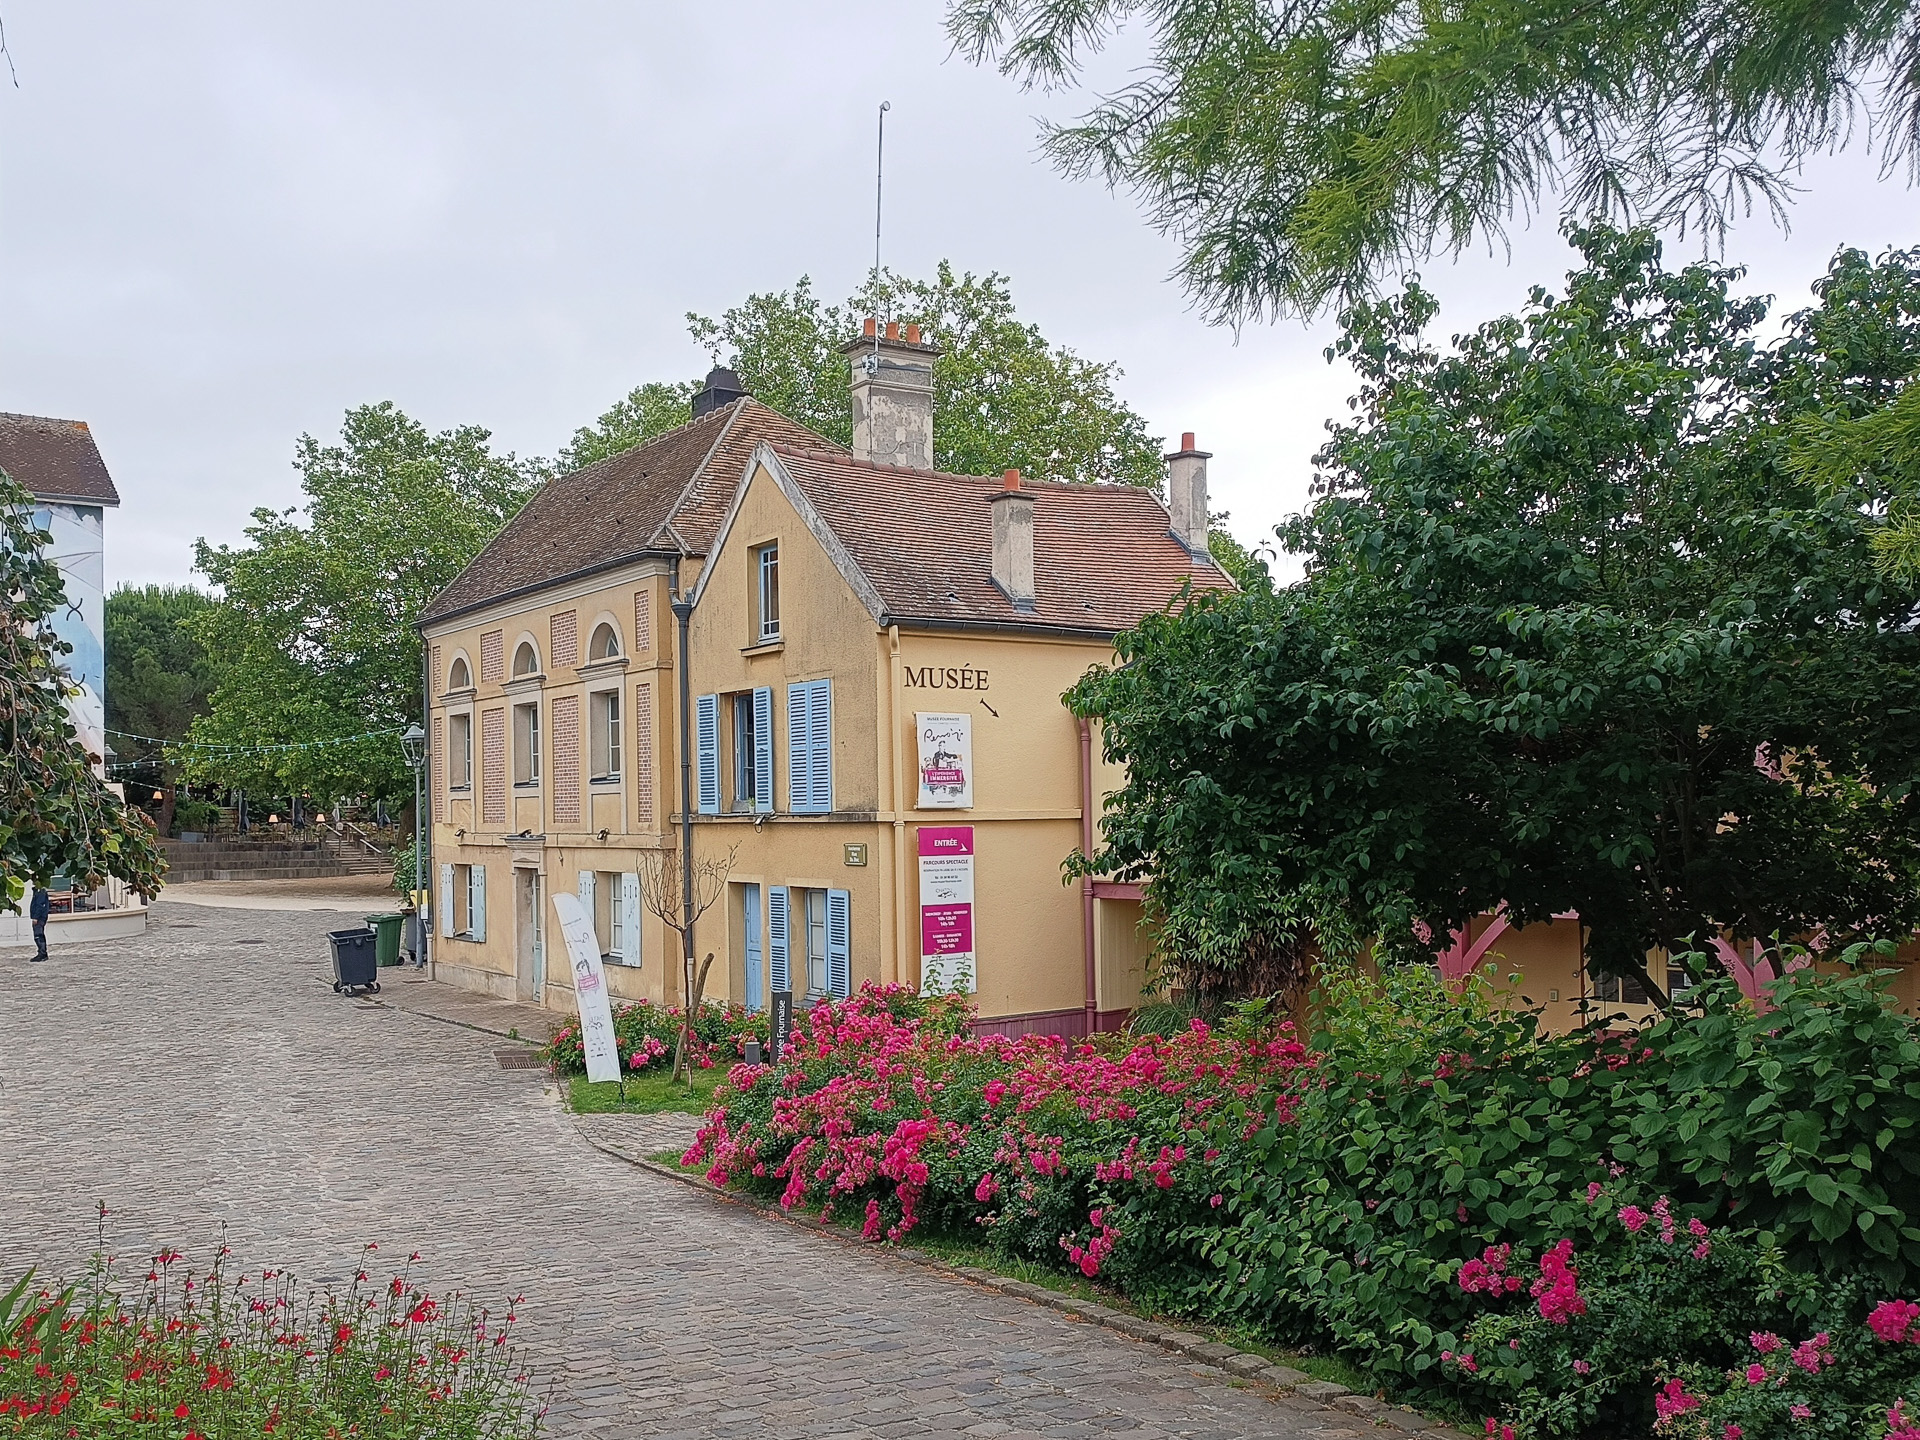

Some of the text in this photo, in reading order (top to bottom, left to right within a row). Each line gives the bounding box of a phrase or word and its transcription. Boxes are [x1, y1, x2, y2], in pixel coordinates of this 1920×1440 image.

[903, 663, 990, 690] MUSÉE
[933, 838, 958, 847] ENTRÉE
[776, 1000, 786, 1062] usée Fournaise
